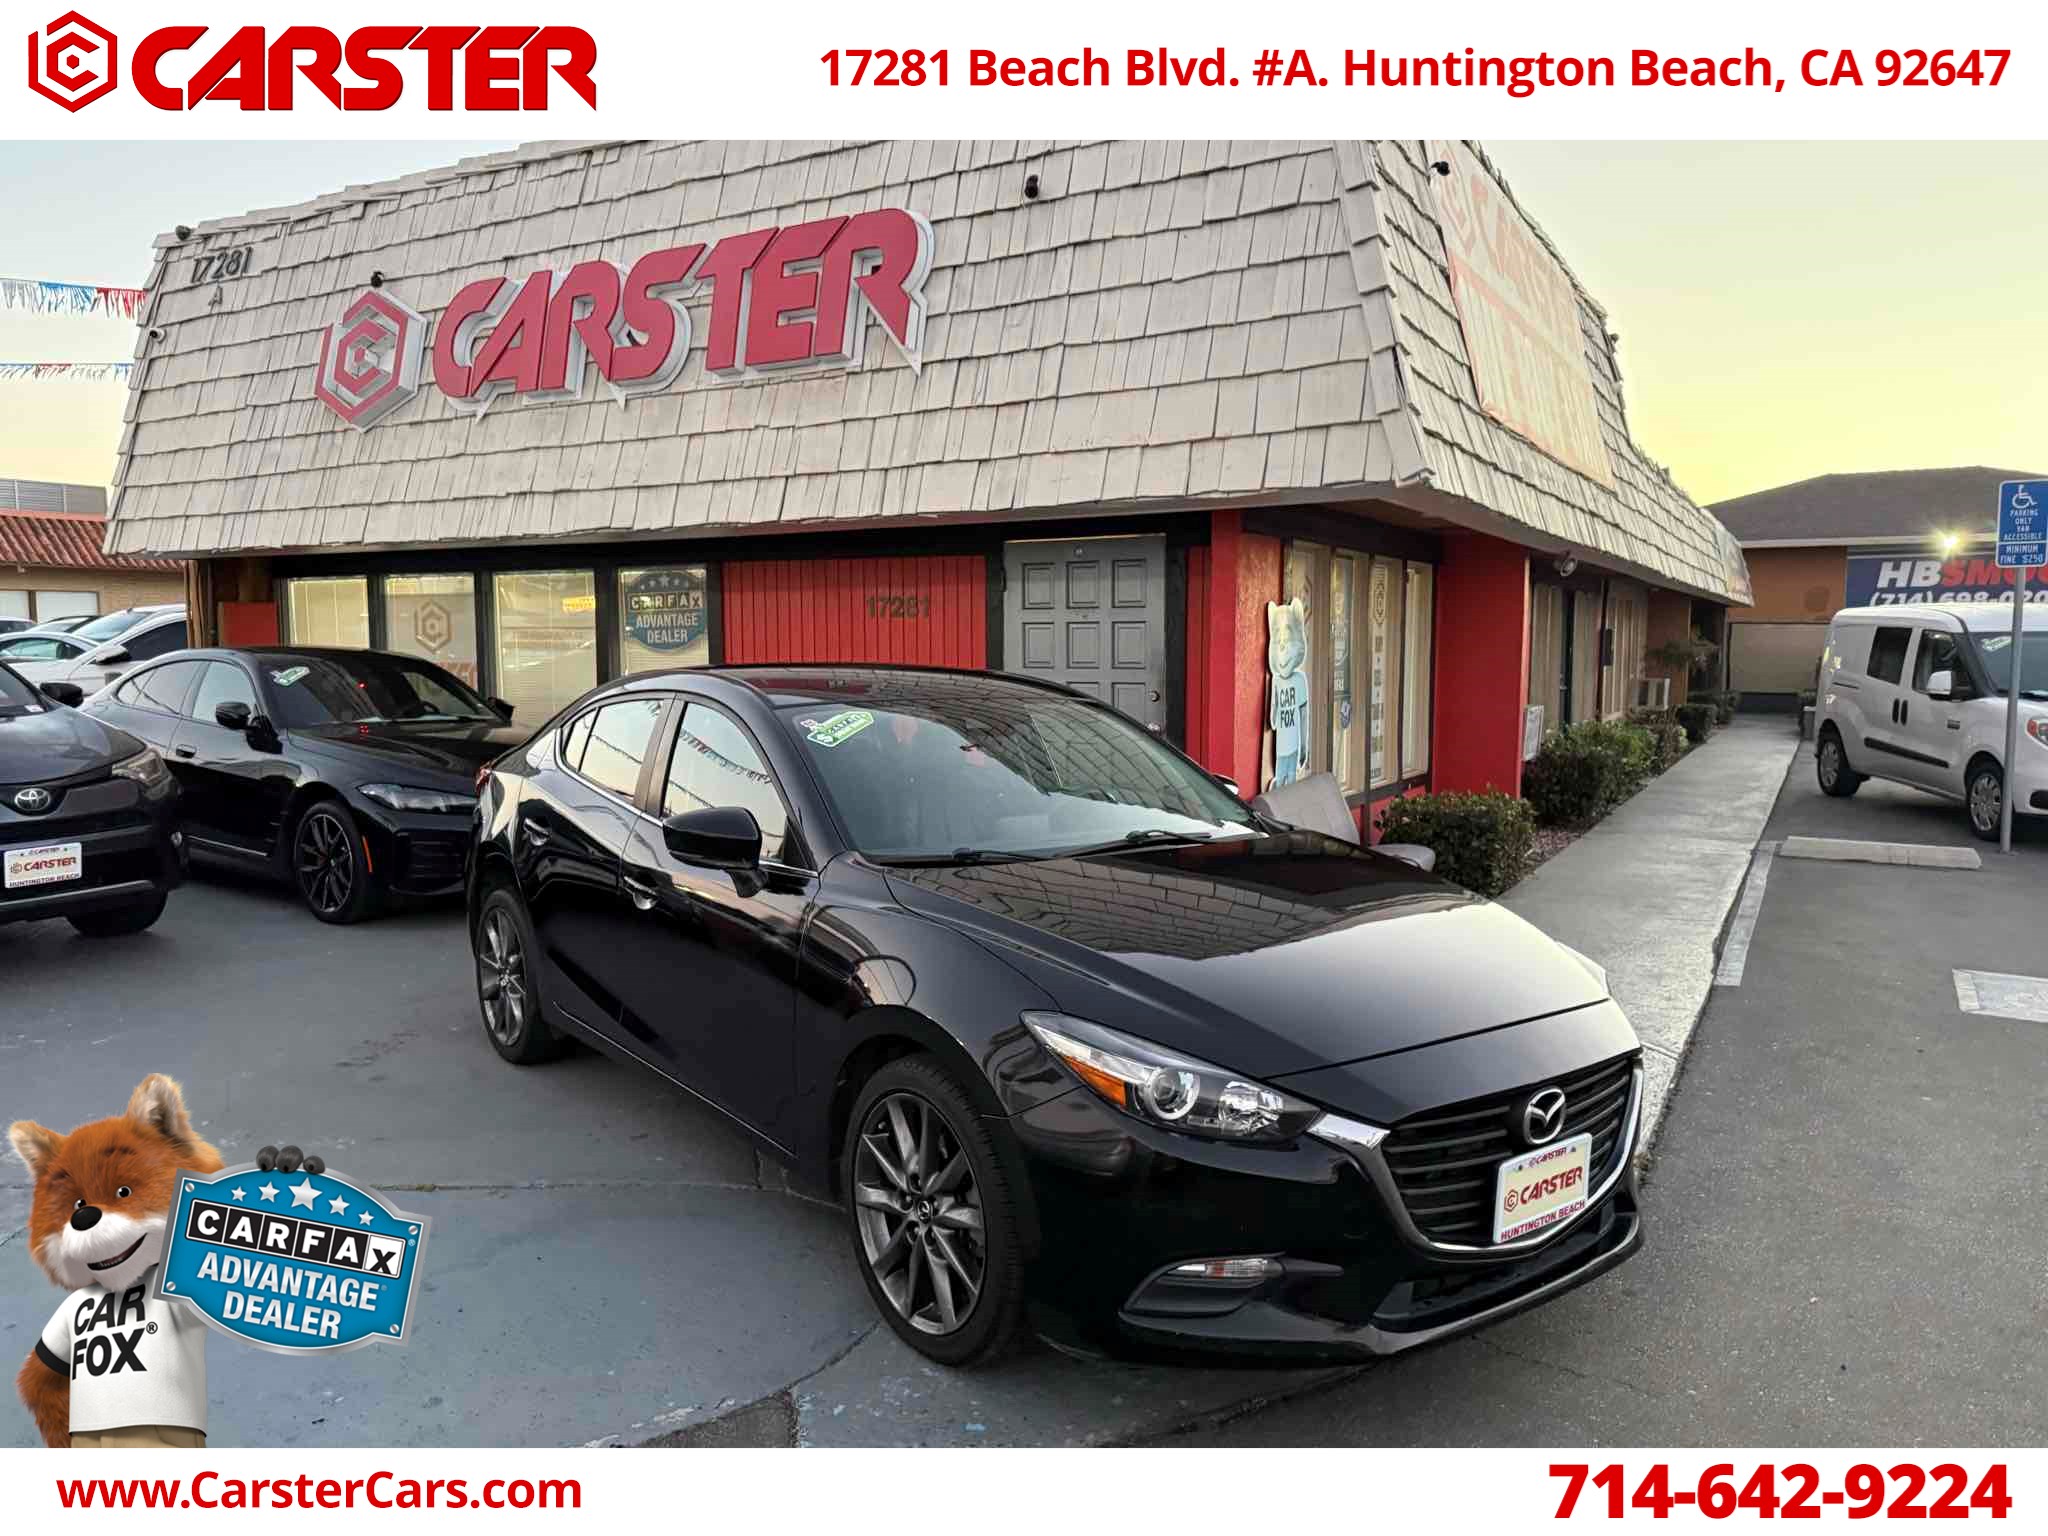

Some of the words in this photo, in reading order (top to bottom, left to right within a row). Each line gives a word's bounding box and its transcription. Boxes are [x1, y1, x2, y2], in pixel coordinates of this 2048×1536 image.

[191, 246, 254, 284] 17281
[432, 207, 926, 402] CARSTER
[2009, 508, 2039, 517] PARKING
[2015, 517, 2032, 525] ONLY
[2003, 532, 2042, 541] ACCESSIBLE
[2006, 543, 2039, 554] MINIMUM
[2000, 554, 2016, 565] FINE
[631, 590, 705, 610] CARFAX
[865, 595, 929, 618] 17281
[635, 612, 699, 629] ADVANTAGE
[647, 627, 689, 644] DEALER
[1280, 687, 1296, 708] CAR
[1280, 707, 1296, 729] FOX
[24, 856, 77, 872] CARSTER
[1519, 1165, 1584, 1205] CARSTER
[1500, 1211, 1557, 1241] HUNTINGTON
[1558, 1199, 1586, 1218] BEACH
